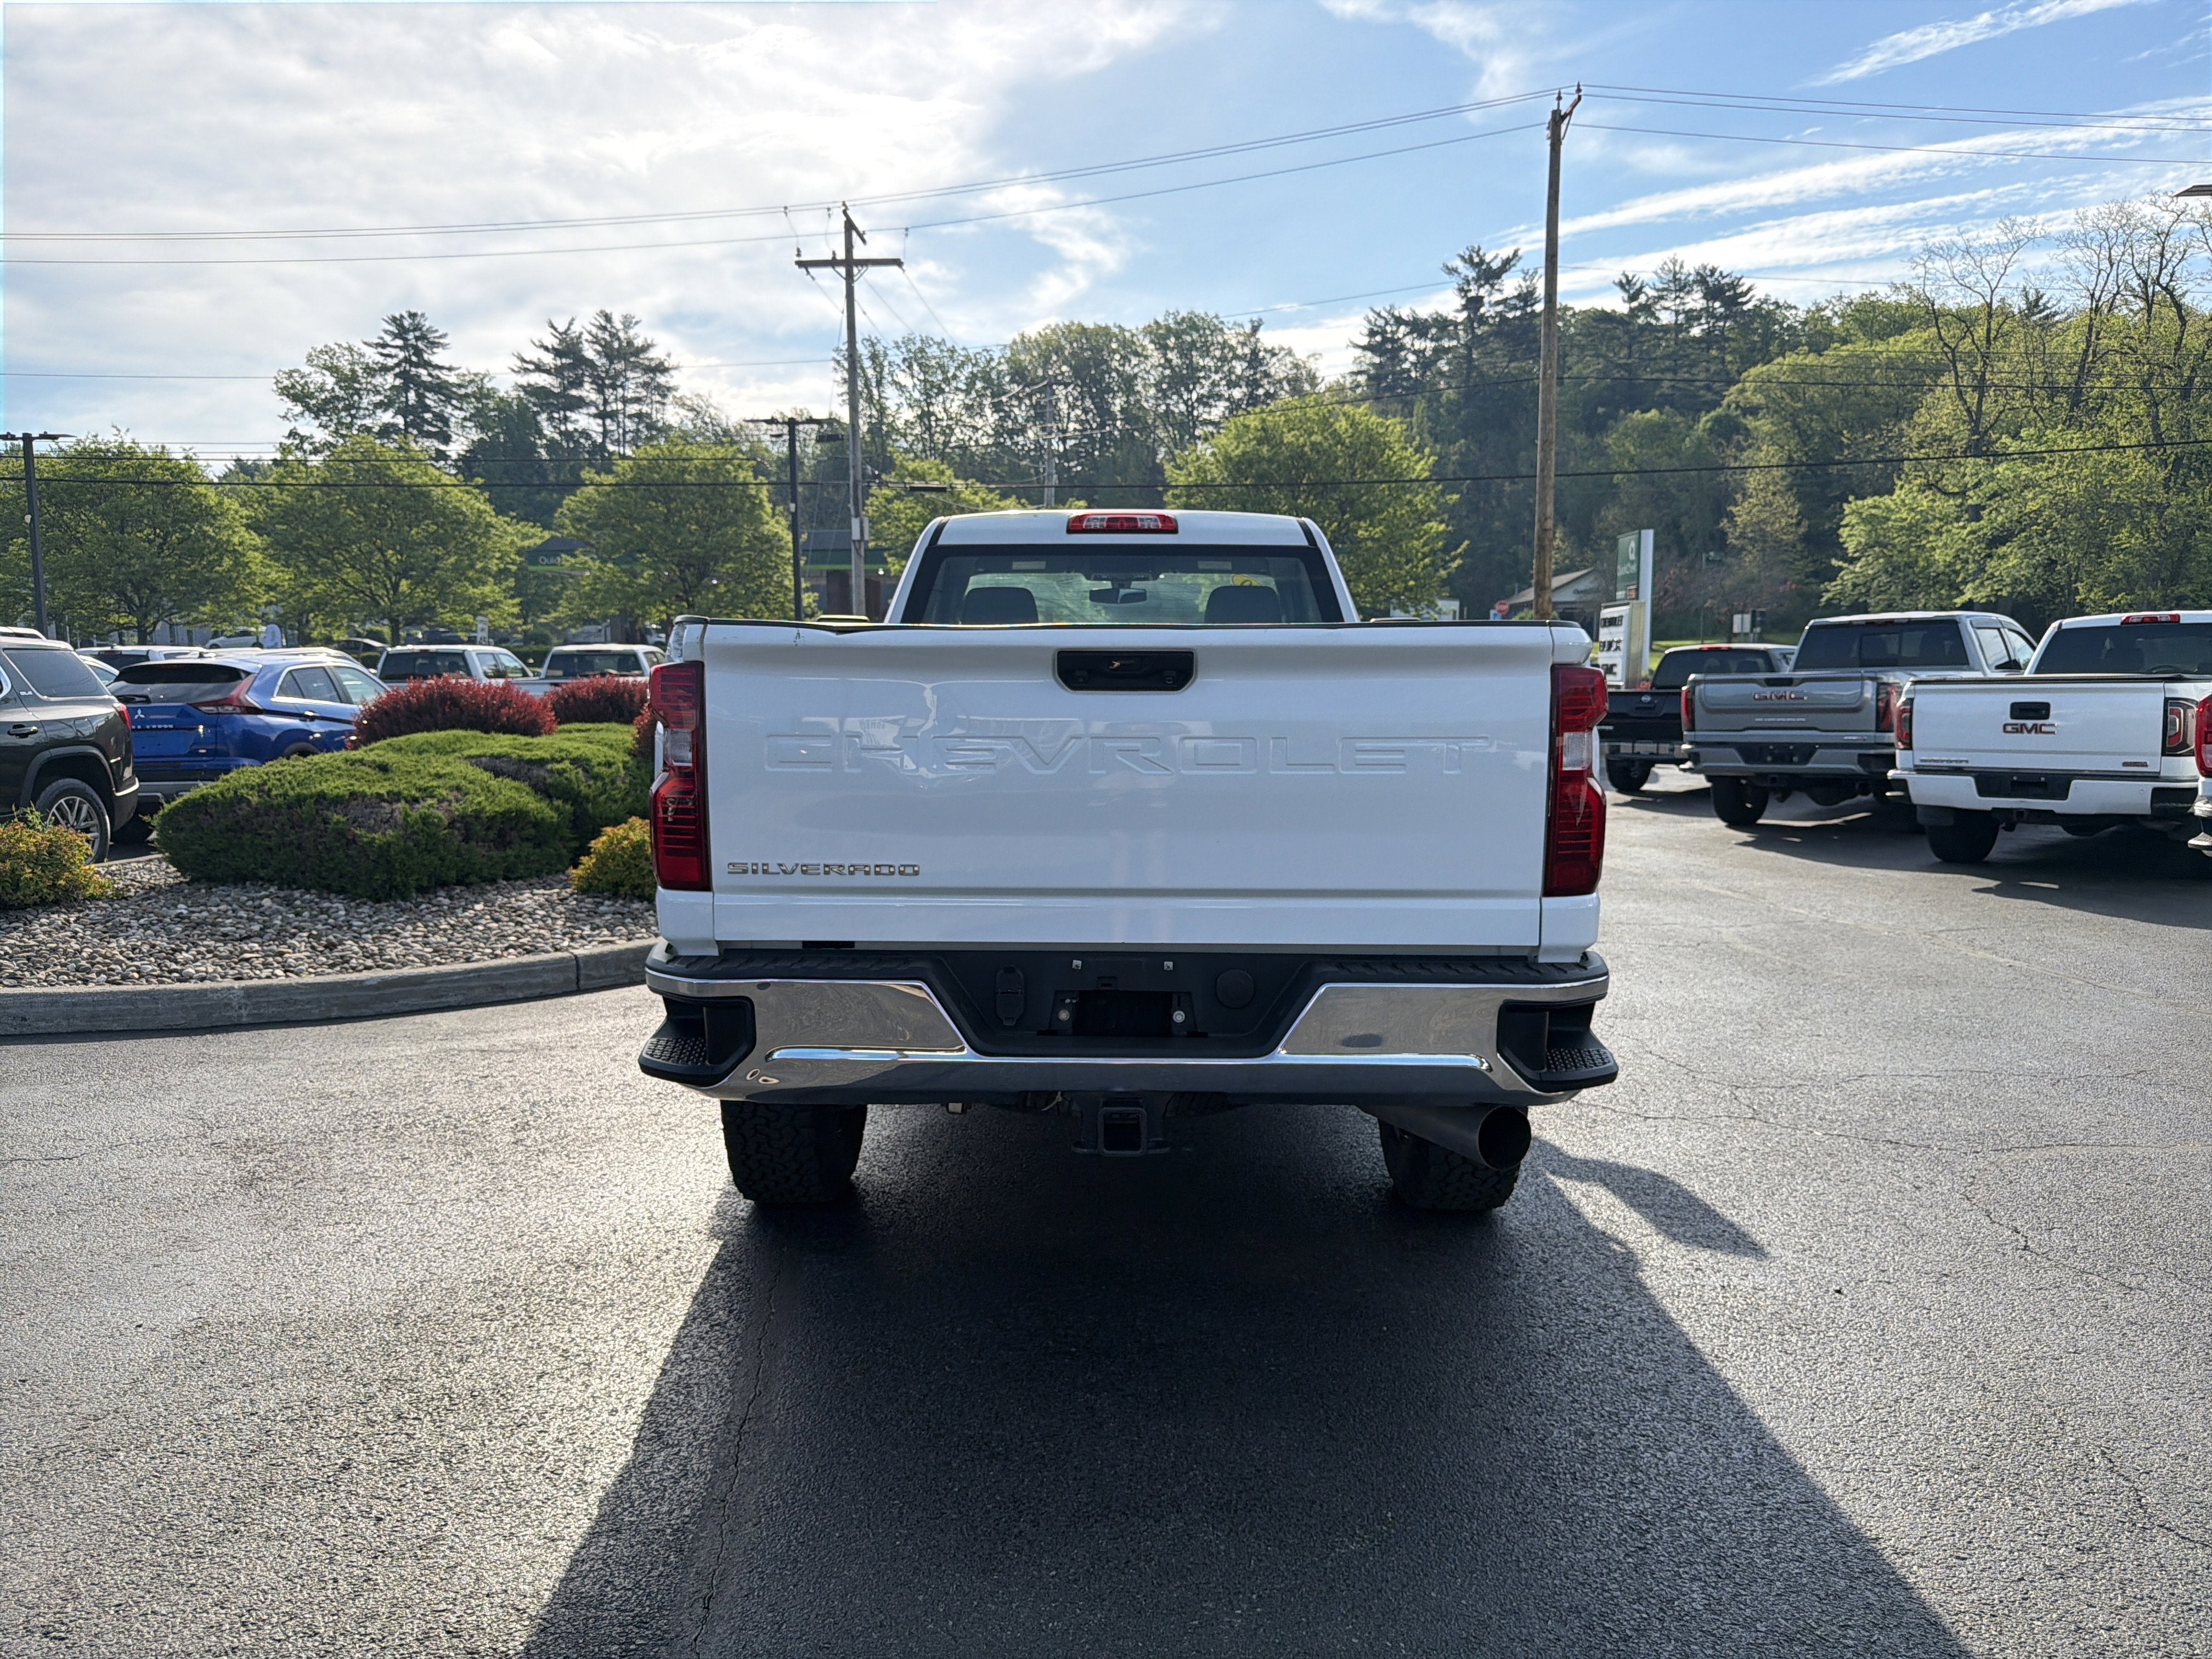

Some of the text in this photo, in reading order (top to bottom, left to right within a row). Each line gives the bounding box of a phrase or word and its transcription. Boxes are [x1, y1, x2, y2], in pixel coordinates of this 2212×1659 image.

[1753, 690, 1807, 701] GMC
[2002, 723, 2057, 735] GMC
[764, 734, 1489, 775] CHEVROLET
[727, 862, 920, 876] SILVERADO
